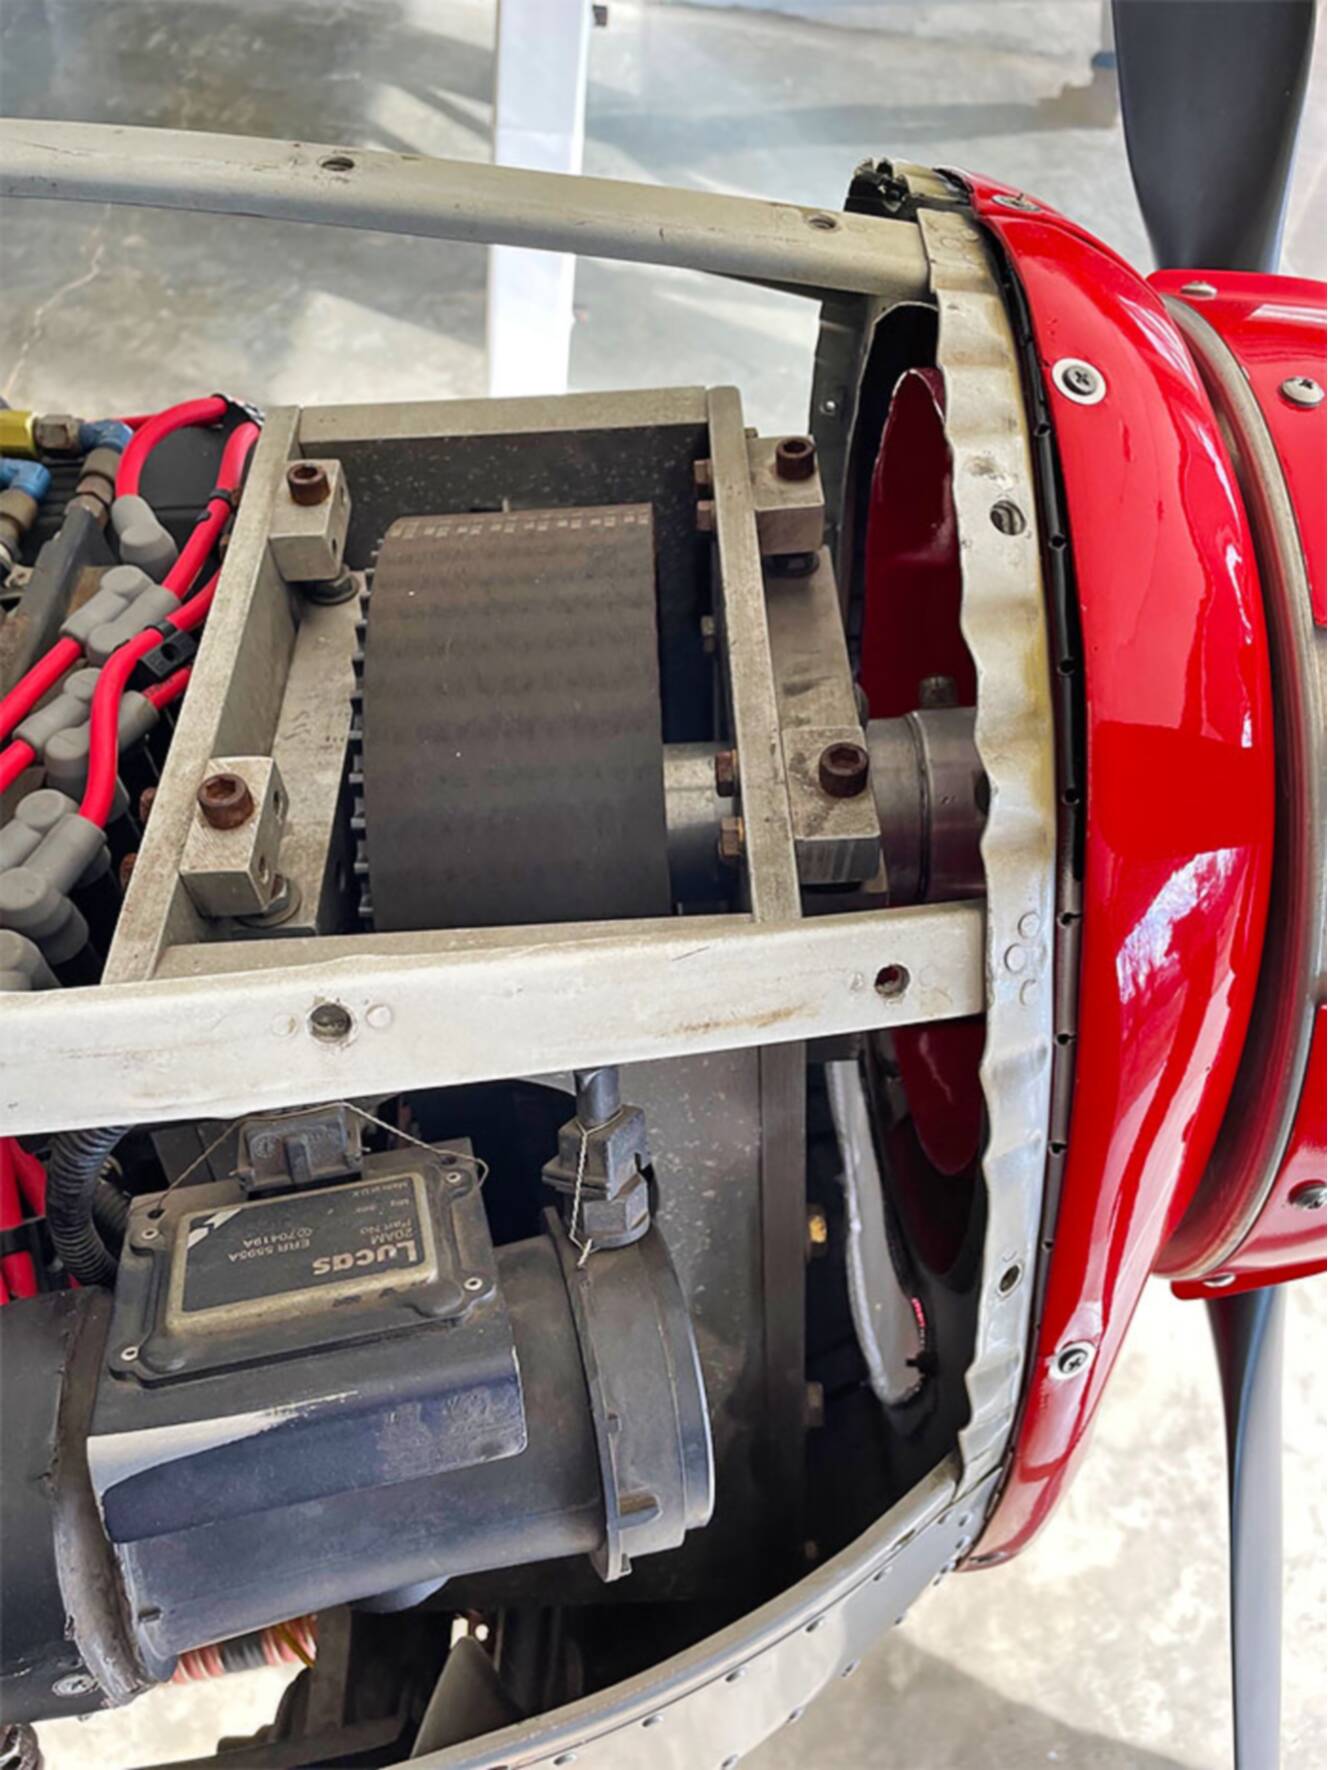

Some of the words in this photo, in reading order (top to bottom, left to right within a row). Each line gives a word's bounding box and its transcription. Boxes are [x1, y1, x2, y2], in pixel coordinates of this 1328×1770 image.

[383, 1218, 412, 1231] Part
[370, 1227, 412, 1245] 20AM
[278, 1238, 311, 1253] ERR
[312, 1240, 417, 1275] Lucas
